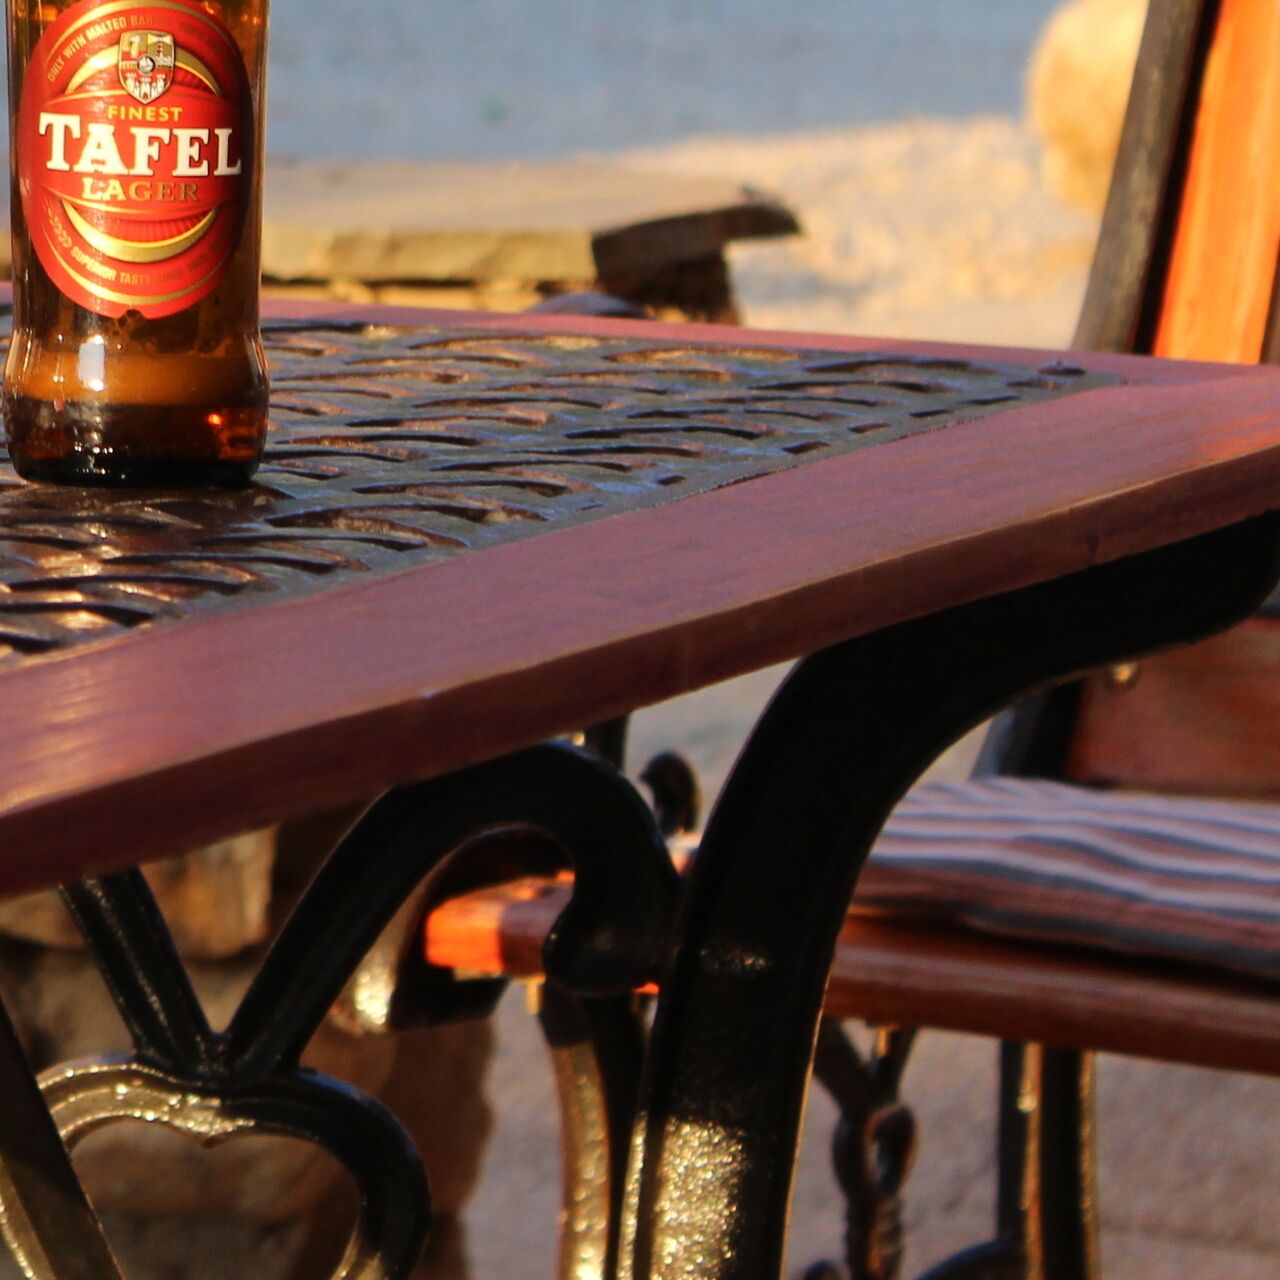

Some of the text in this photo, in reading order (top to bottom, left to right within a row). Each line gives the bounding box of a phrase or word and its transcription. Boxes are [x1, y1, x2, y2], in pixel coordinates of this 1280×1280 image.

[47, 56, 65, 82] ONLY
[62, 34, 87, 59] WITH
[85, 16, 127, 41] MALTED
[107, 106, 183, 122] FINEST
[38, 112, 242, 177] TAFEL
[81, 177, 200, 202] LAGER
[71, 246, 117, 282] SUPERIOR
